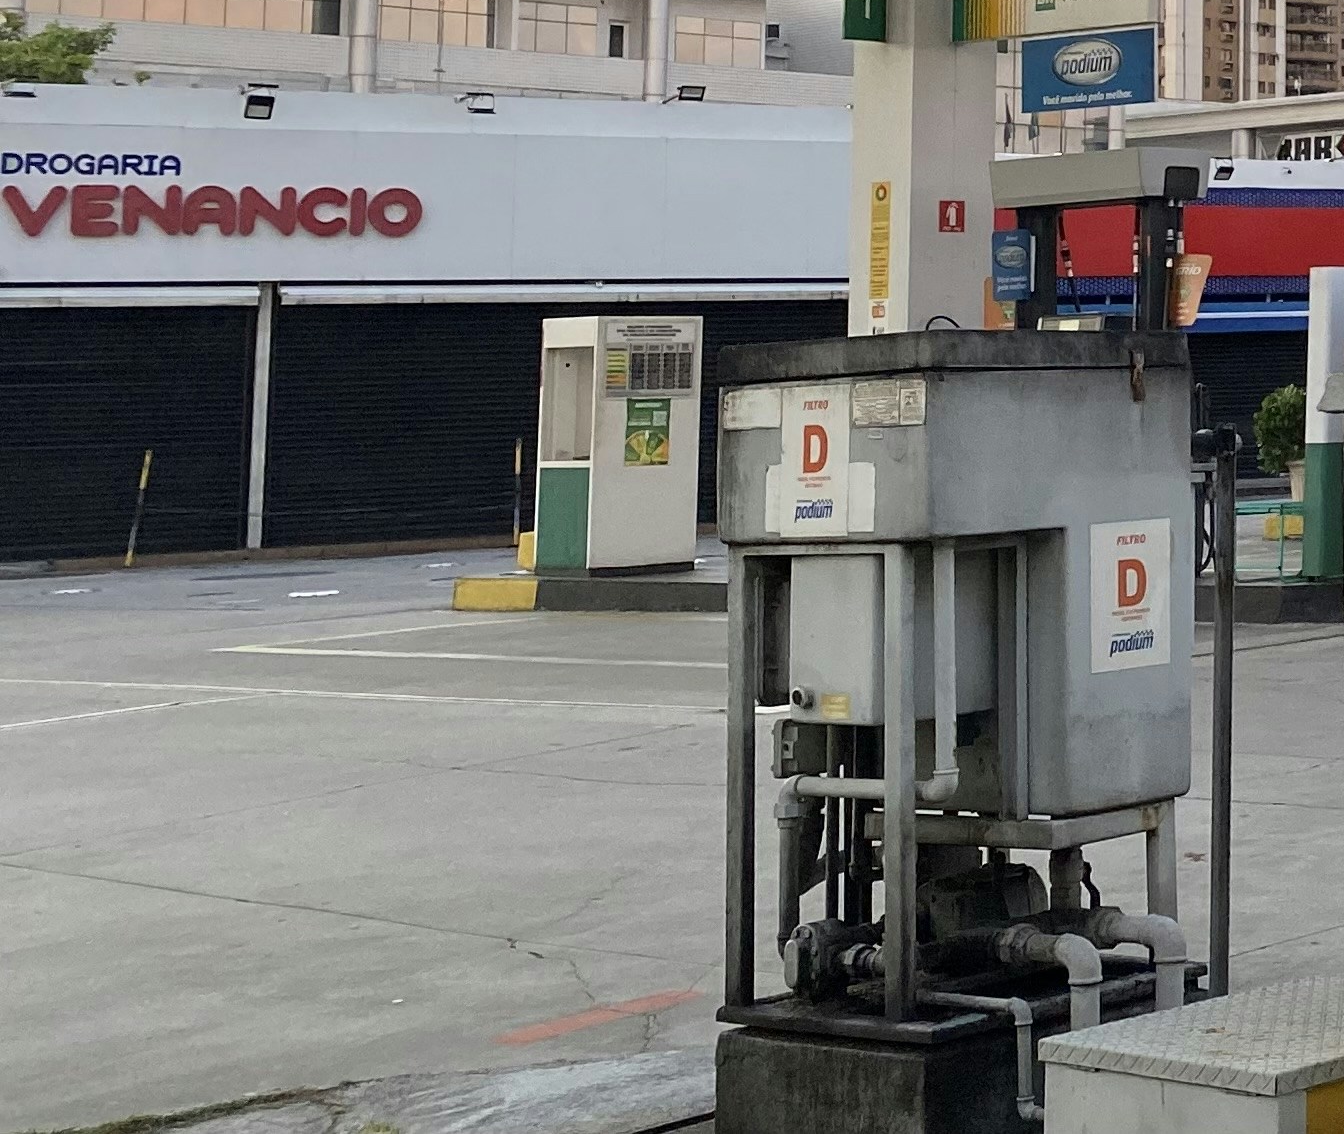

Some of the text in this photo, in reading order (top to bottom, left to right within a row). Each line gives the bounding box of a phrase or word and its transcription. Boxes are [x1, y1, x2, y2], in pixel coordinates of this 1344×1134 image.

[1061, 54, 1113, 76] podium
[1, 152, 182, 177] DROGARIA
[2, 184, 423, 238] VENANCIO
[803, 399, 829, 411] FILTRO
[803, 424, 828, 474] D
[794, 503, 833, 523] podium
[1116, 534, 1146, 546] FILTRO
[1117, 558, 1147, 607] D
[1110, 635, 1154, 657] podium
